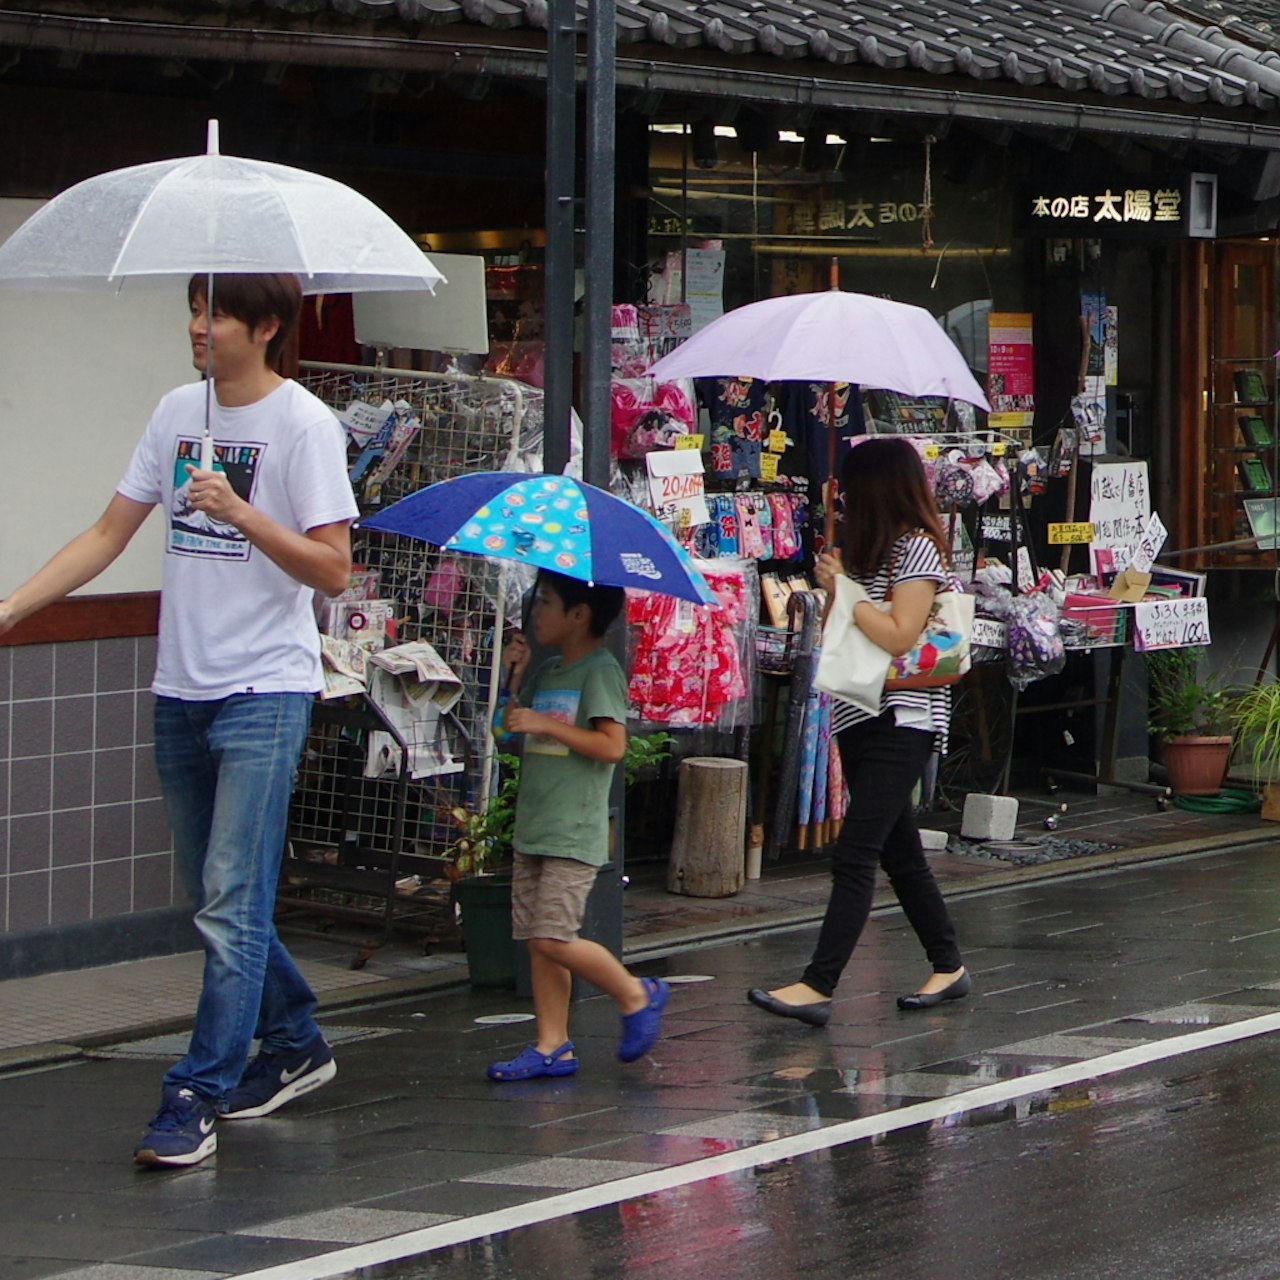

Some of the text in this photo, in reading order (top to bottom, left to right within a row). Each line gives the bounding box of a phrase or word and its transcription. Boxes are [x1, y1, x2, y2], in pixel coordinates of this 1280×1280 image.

[1031, 188, 1182, 222] 本の店 太陽堂
